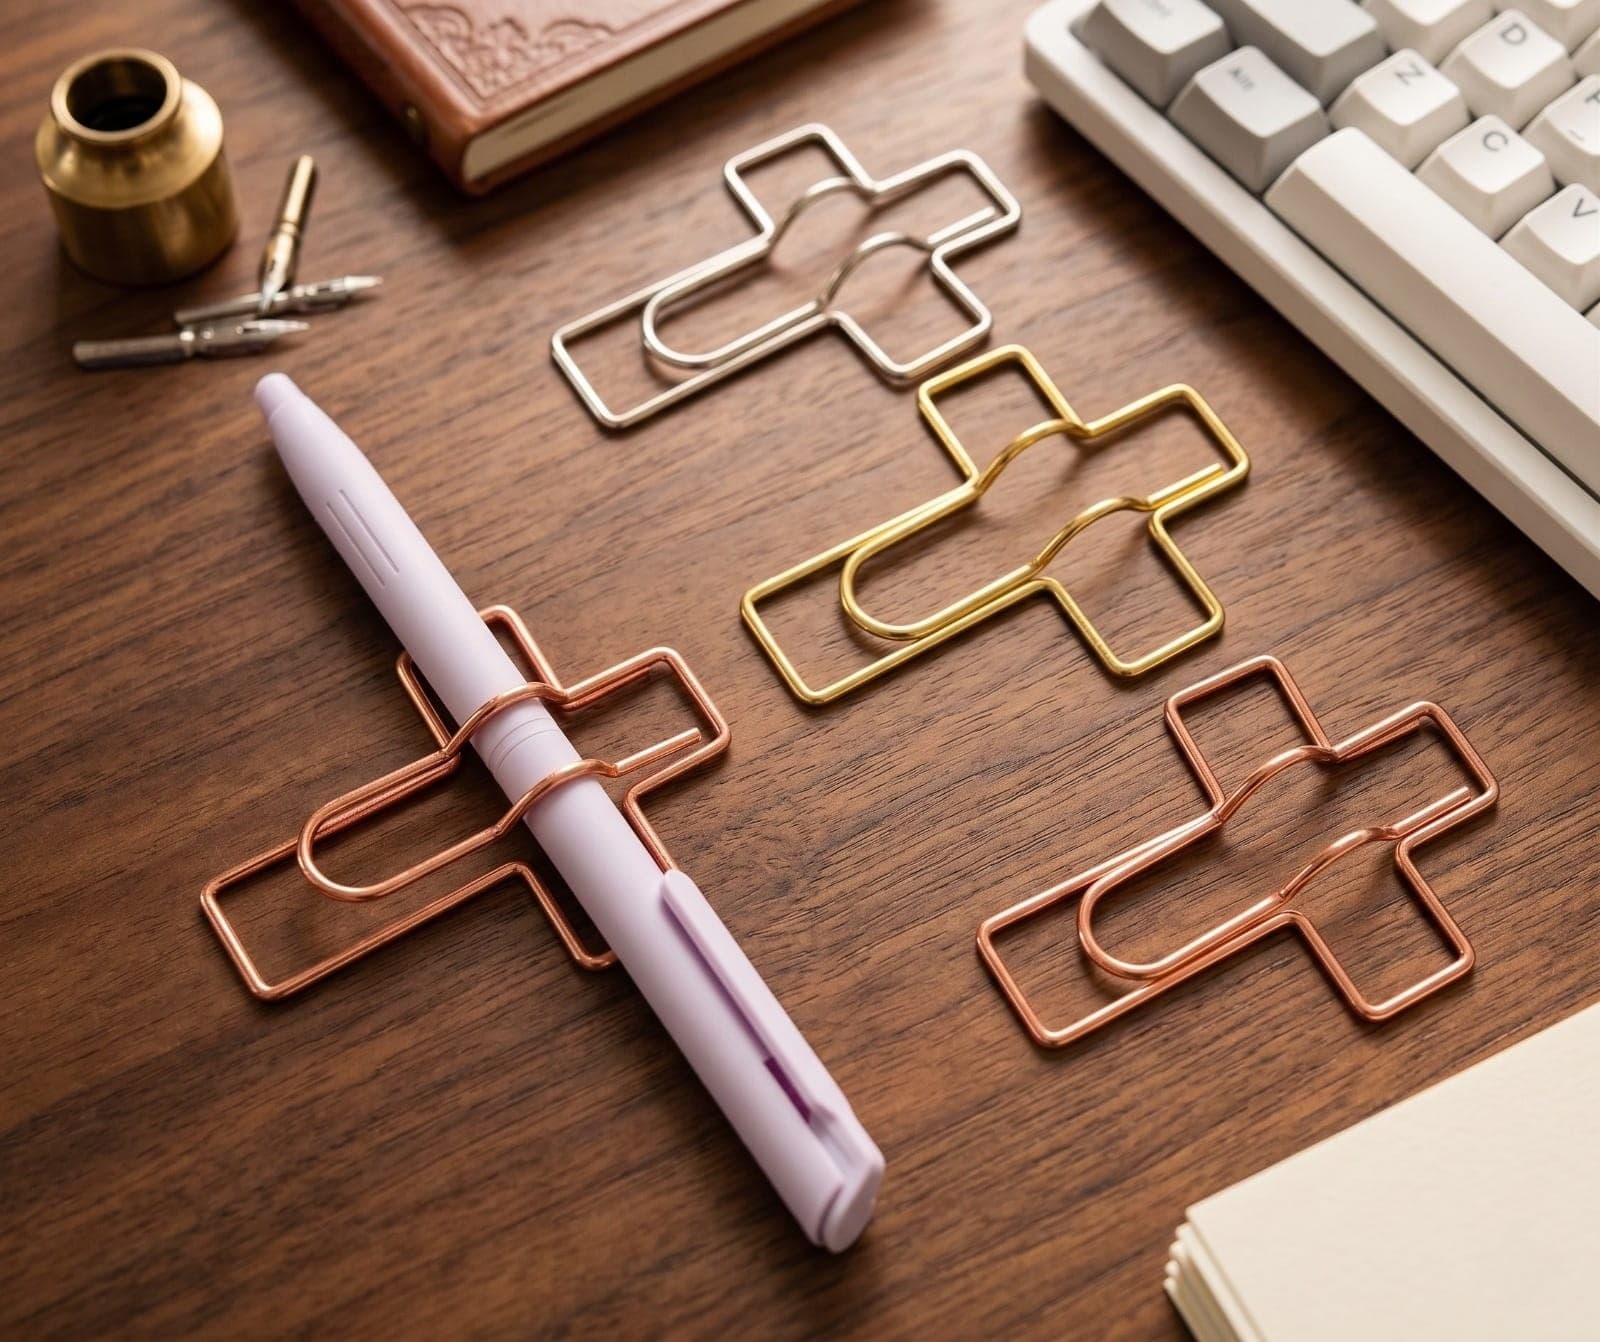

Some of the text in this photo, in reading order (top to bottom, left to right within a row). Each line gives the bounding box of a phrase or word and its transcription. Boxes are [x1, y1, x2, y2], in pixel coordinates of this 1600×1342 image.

[1500, 22, 1528, 46] D
[1394, 63, 1425, 86] Z
[1482, 130, 1509, 152] C
[1572, 198, 1599, 218] V
